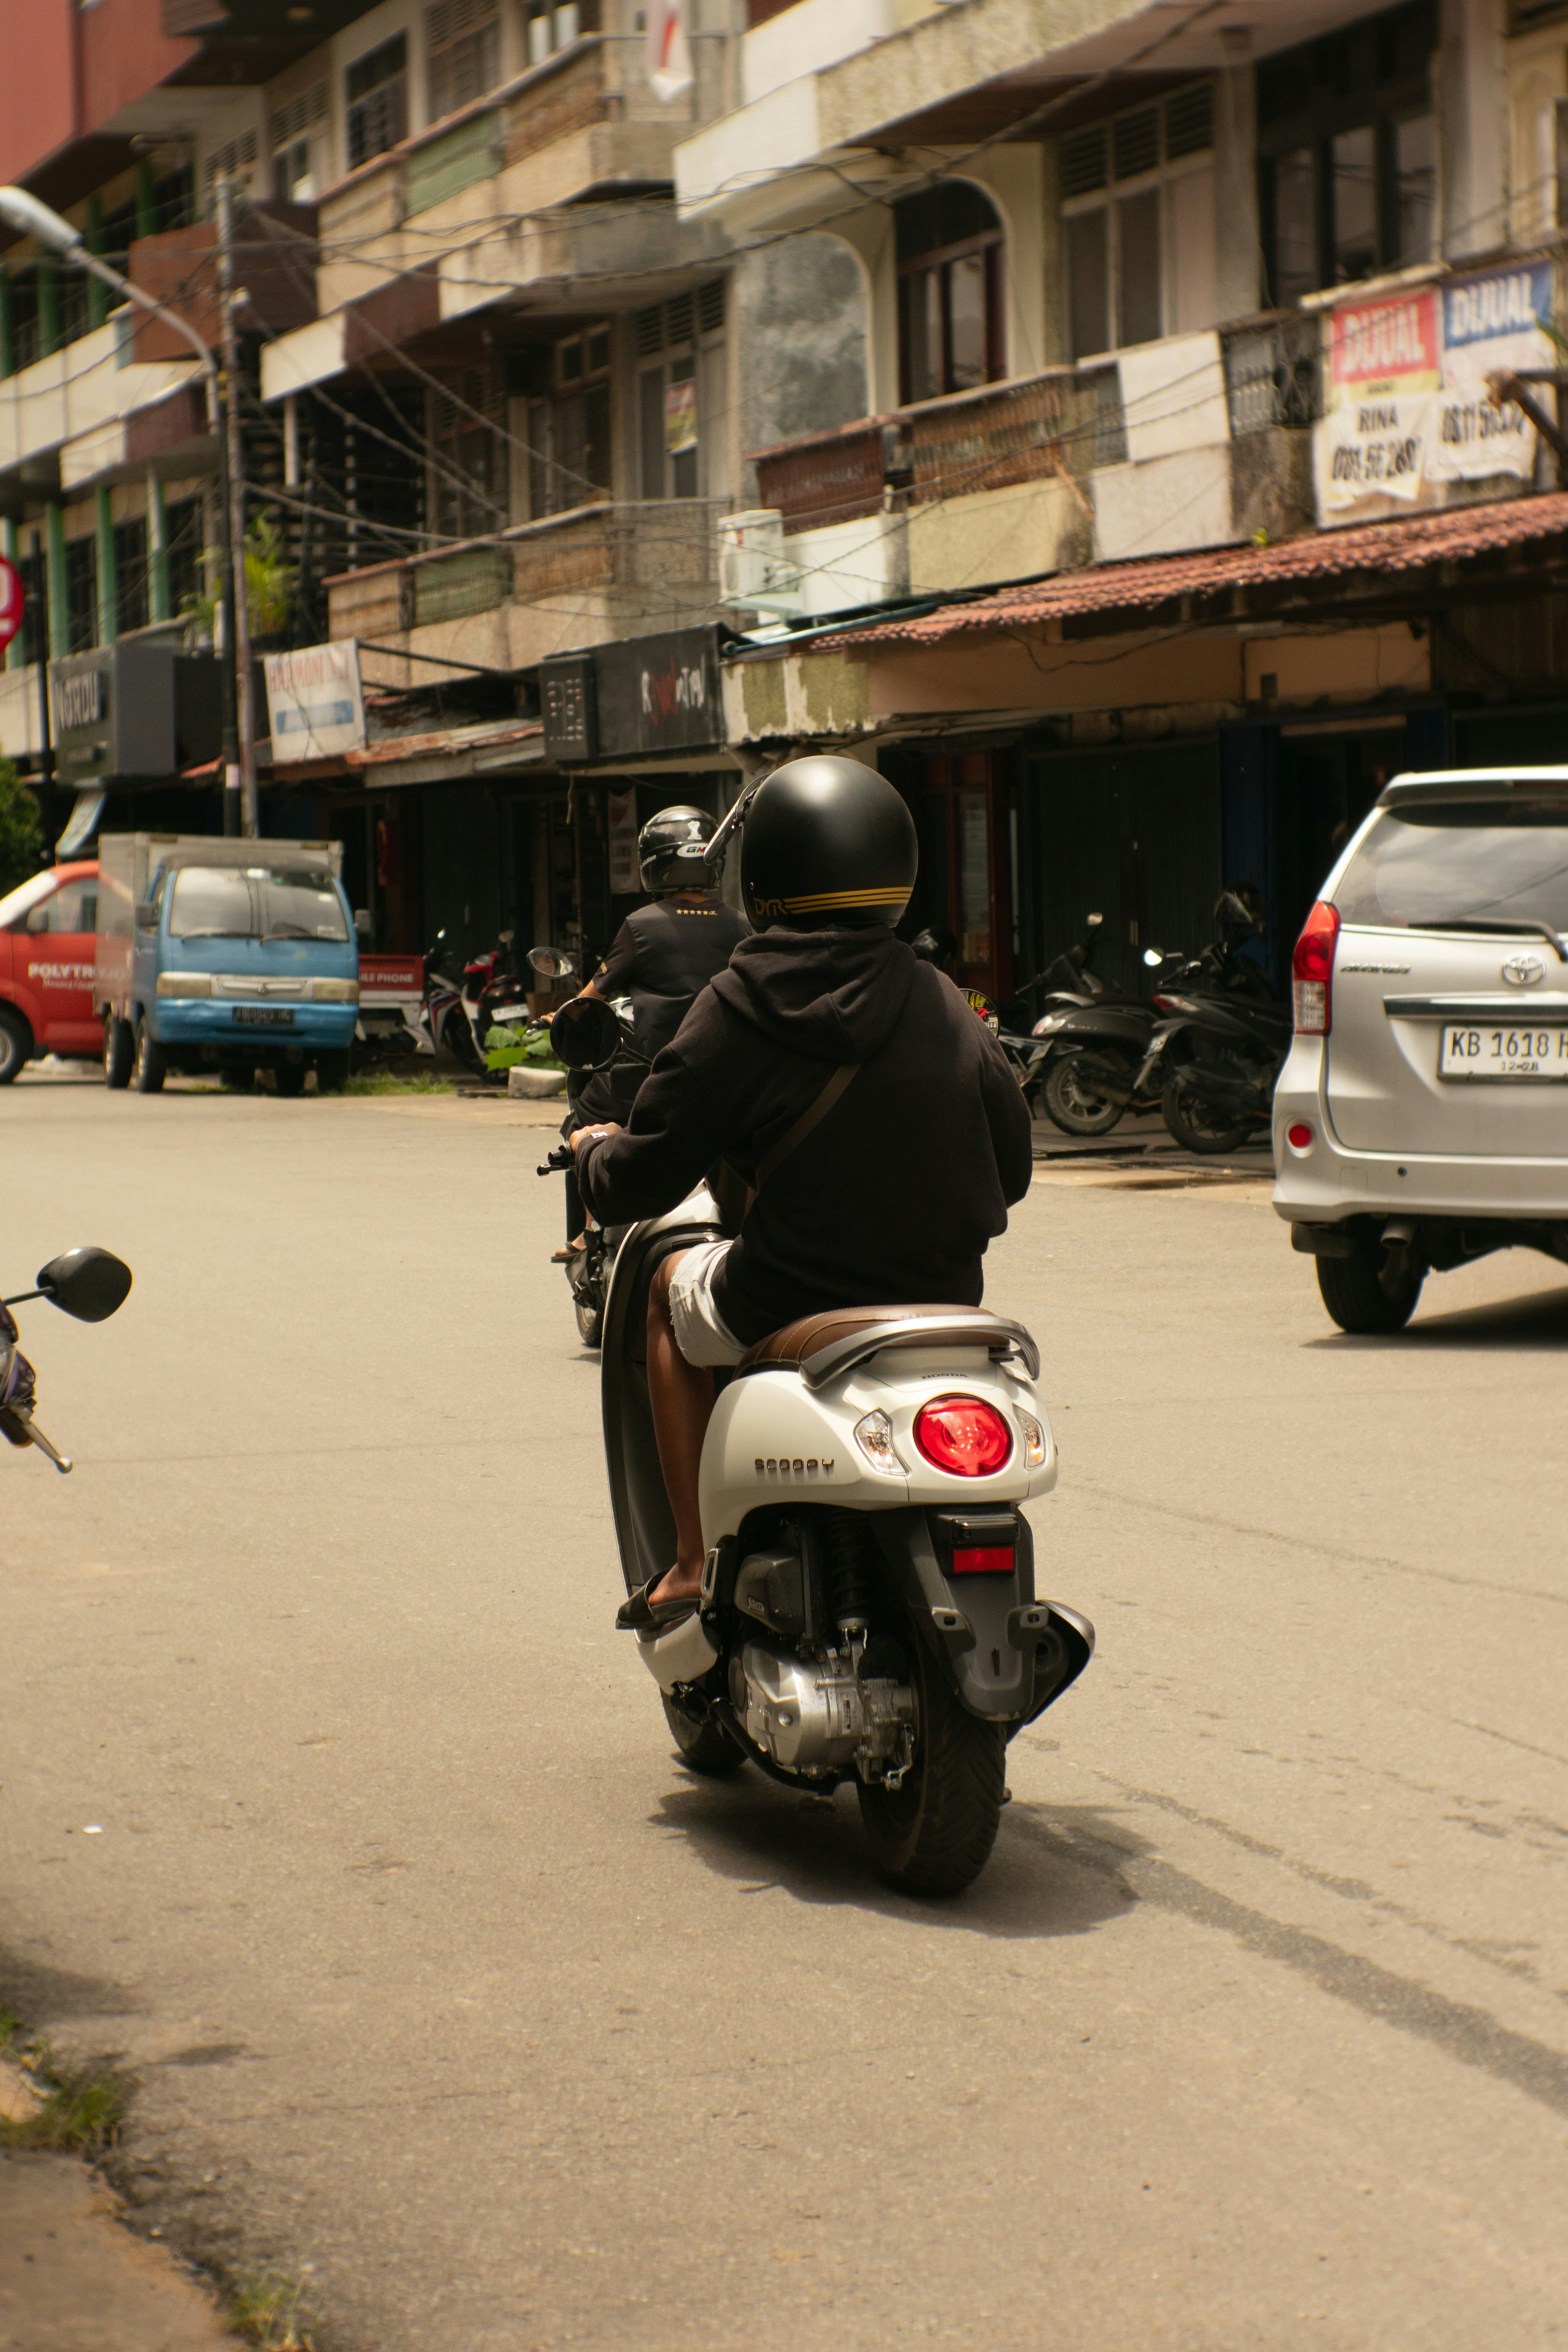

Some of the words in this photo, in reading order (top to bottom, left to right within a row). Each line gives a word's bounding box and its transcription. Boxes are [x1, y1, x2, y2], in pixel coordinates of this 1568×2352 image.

[1452, 272, 1535, 337] DIJUAL
[1358, 401, 1399, 433] RINA
[28, 962, 95, 980] POLYTR
[377, 973, 414, 983] PHONE
[1451, 1031, 1481, 1057] KB
[1490, 1031, 1549, 1057] 1618
[754, 1458, 835, 1472] SCOOPY
